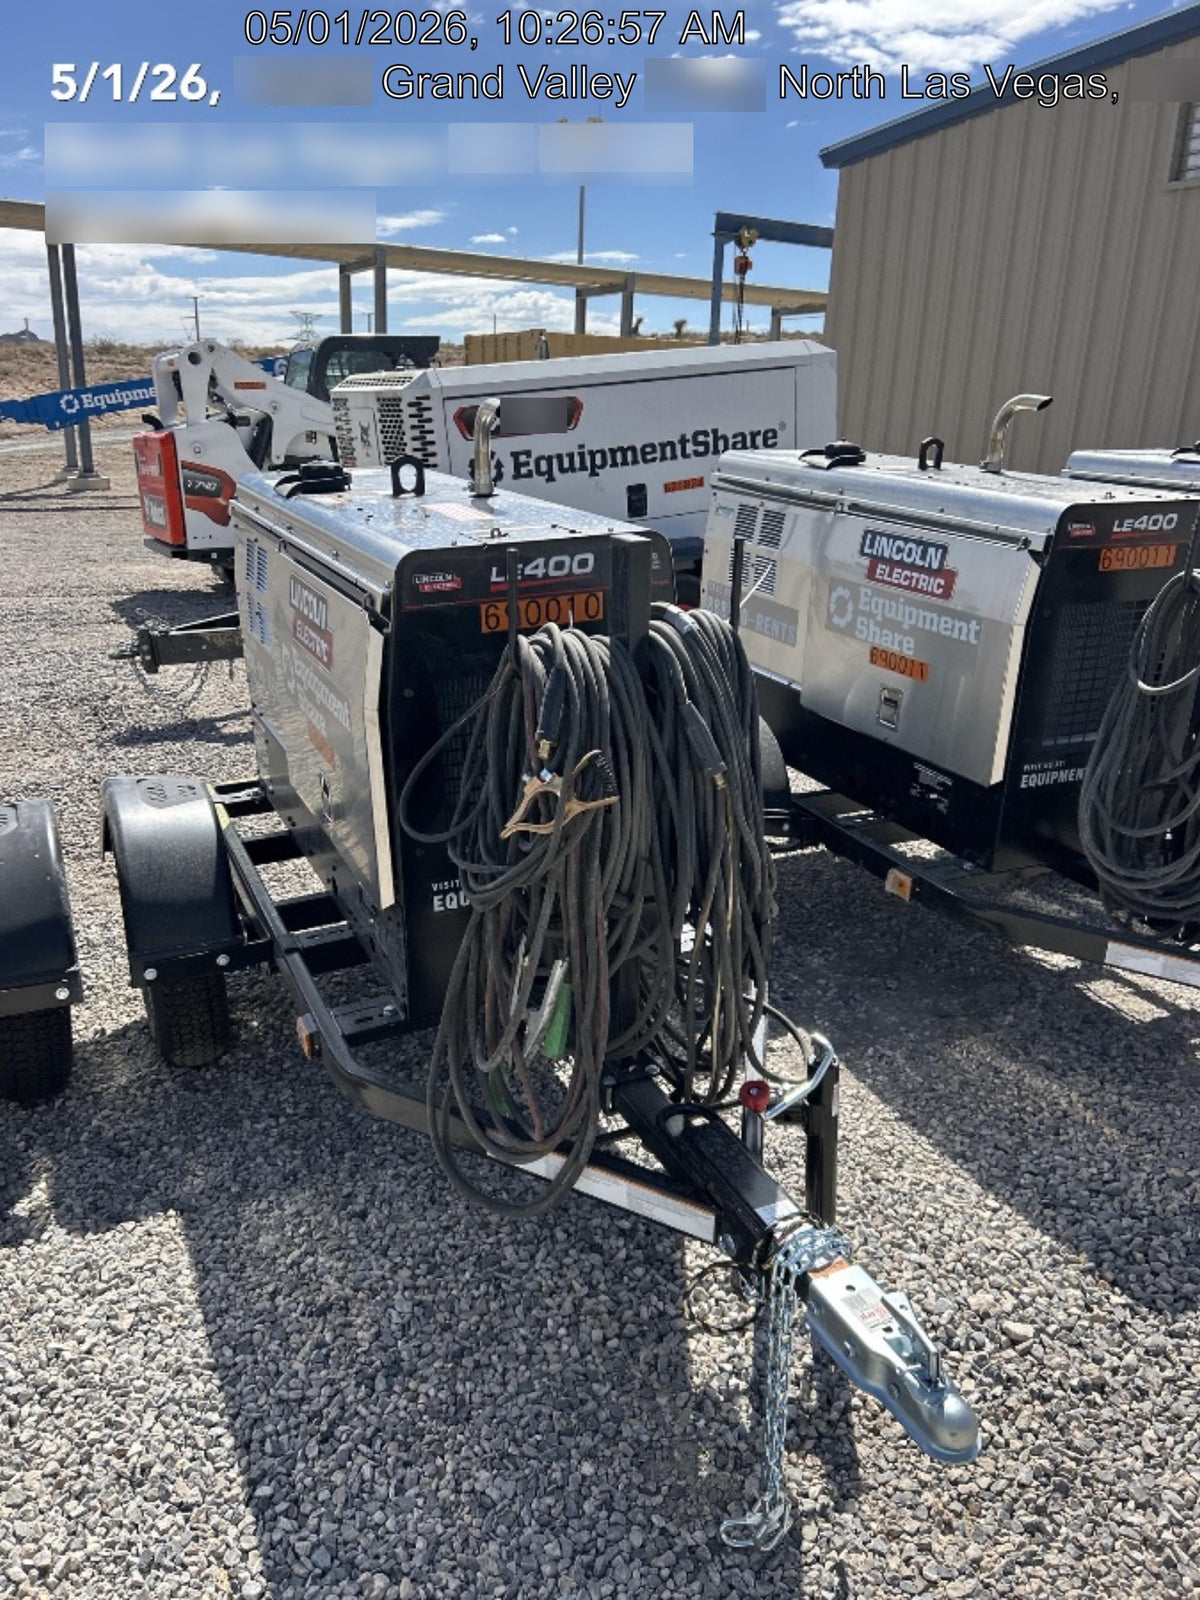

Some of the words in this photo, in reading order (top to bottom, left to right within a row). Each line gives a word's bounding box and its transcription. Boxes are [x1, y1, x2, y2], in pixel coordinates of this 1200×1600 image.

[510, 427, 778, 485] EquipmentShare
[1112, 513, 1178, 532] LE400
[863, 534, 943, 570] LINCOLN
[876, 564, 945, 595] ELECTRIC
[484, 594, 600, 630] 60010
[857, 587, 981, 644] Equipment
[855, 615, 915, 656] Share
[431, 879, 460, 891] VISIT
